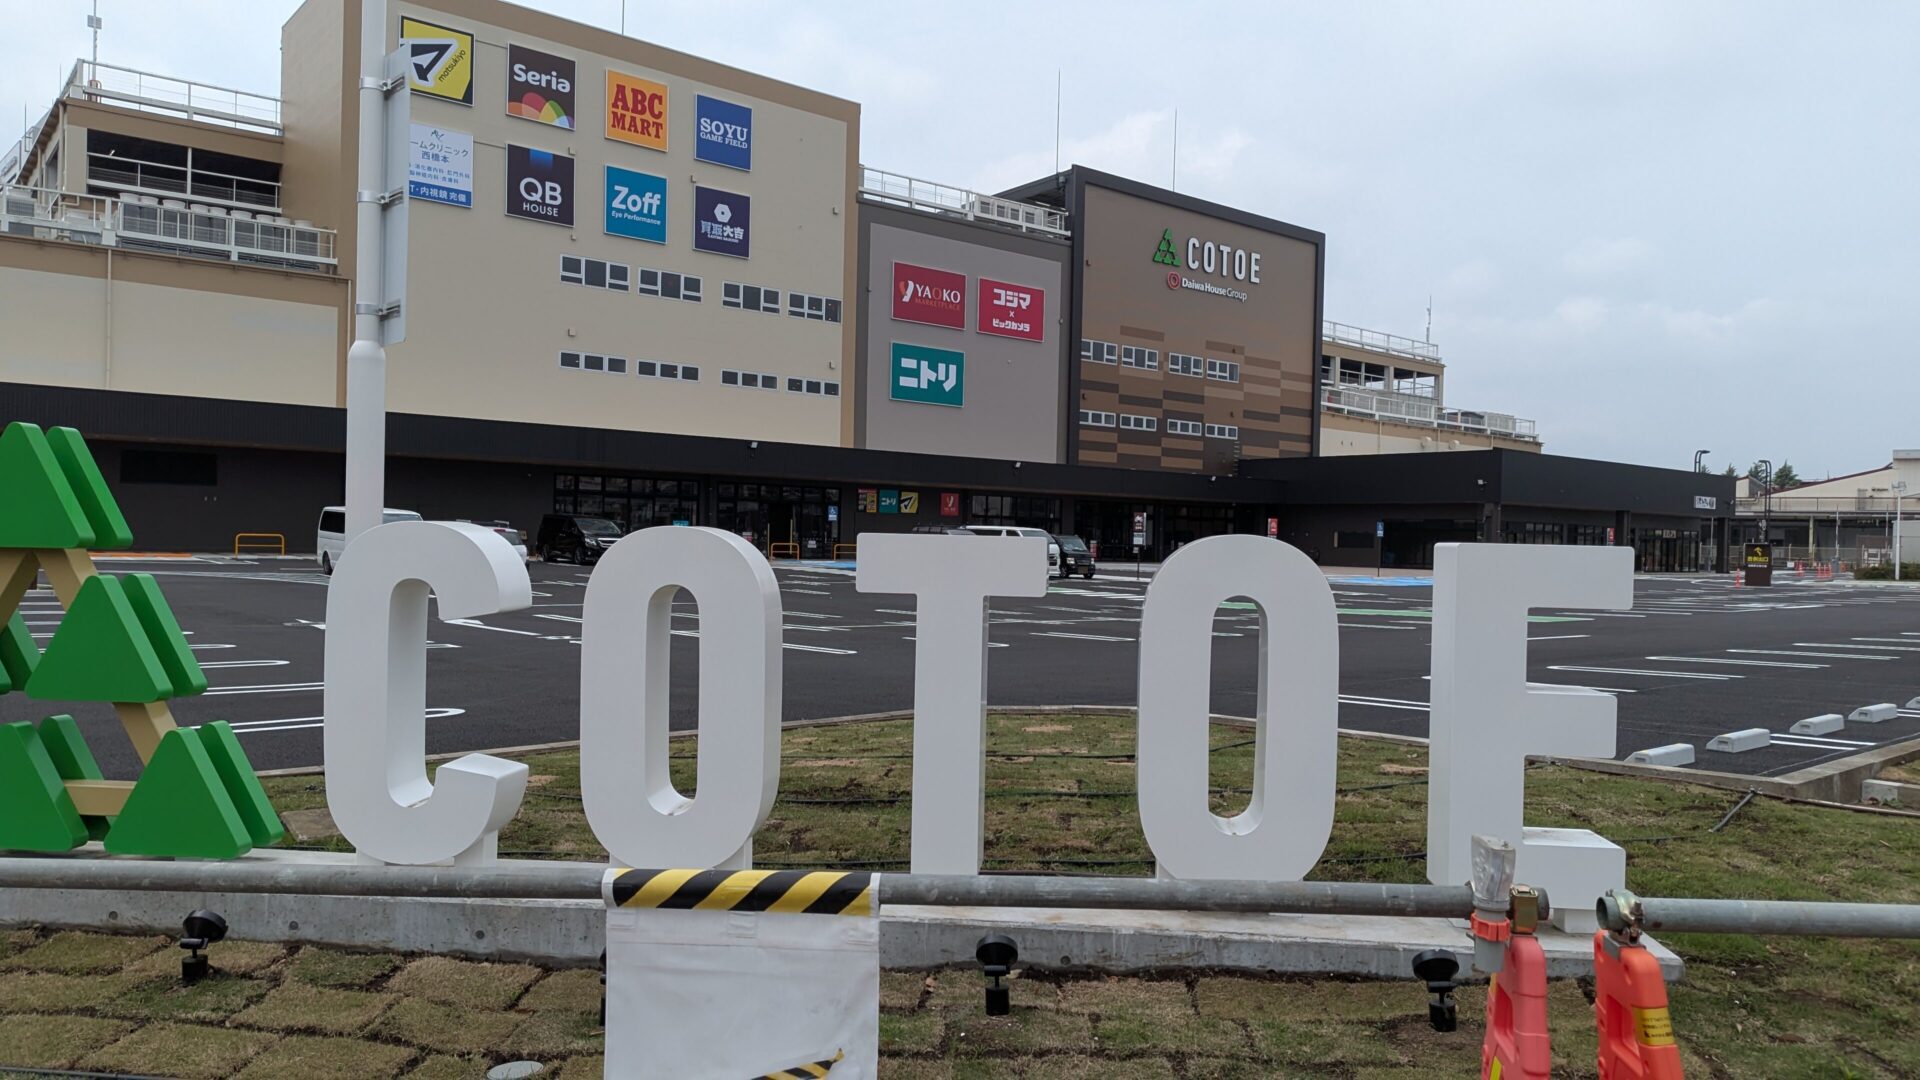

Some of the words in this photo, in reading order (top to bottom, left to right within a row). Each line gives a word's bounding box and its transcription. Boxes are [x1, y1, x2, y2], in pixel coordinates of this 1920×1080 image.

[438, 49, 466, 83] matsukiyo
[513, 63, 571, 93] Seria
[611, 83, 663, 120] ABC
[611, 110, 663, 140] MART
[700, 117, 748, 142] SOYU
[410, 139, 469, 157] ームクリニック
[700, 131, 723, 144] GAME
[725, 137, 748, 149] FIELD
[410, 184, 467, 203] T・内視鏡完備
[519, 177, 562, 206] QB
[611, 184, 661, 216] Zoff
[522, 202, 559, 217] HOUSE
[611, 210, 622, 218] Eye
[623, 212, 661, 226] Performance
[1187, 237, 1260, 284] COTOE
[915, 283, 961, 304] YAOKO
[993, 288, 1031, 310] コジマ
[1181, 277, 1205, 291] Daiwa
[1204, 282, 1227, 296] House
[1226, 287, 1248, 302] Group
[992, 317, 1031, 332] ビックカメラ
[899, 357, 957, 392] ニトリ
[323, 519, 1636, 908] COTOE
